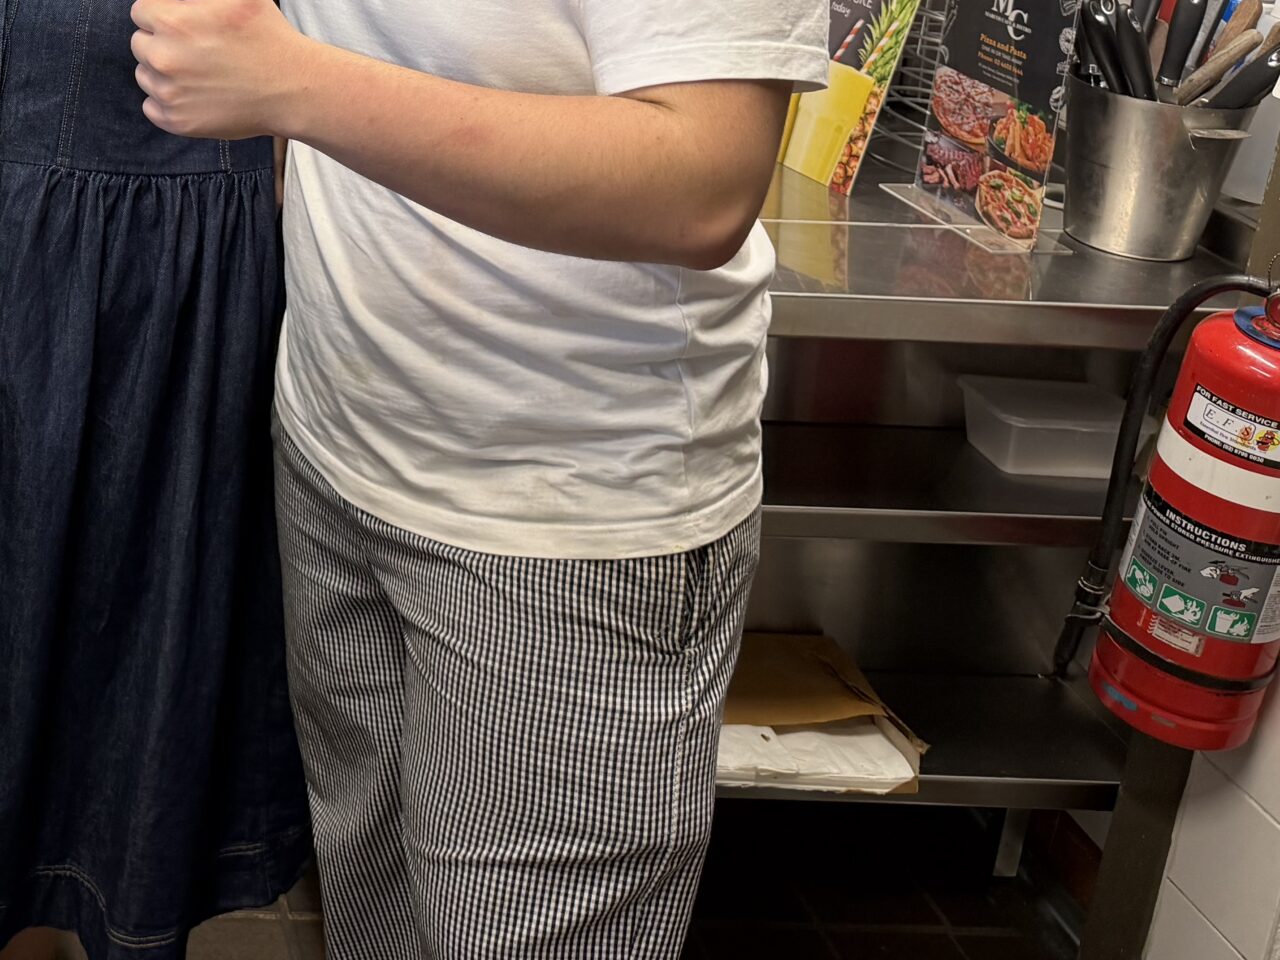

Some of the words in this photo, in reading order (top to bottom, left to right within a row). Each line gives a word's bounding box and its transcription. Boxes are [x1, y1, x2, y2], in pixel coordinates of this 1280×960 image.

[832, 1, 851, 17] today
[1196, 385, 1211, 399] FOR
[1212, 395, 1235, 411] FAST
[1235, 408, 1278, 428] SERVICE
[1166, 509, 1247, 552] INSTRUCTIONS
[1170, 521, 1196, 540] STORED
[1196, 536, 1234, 556] PRESSURE
